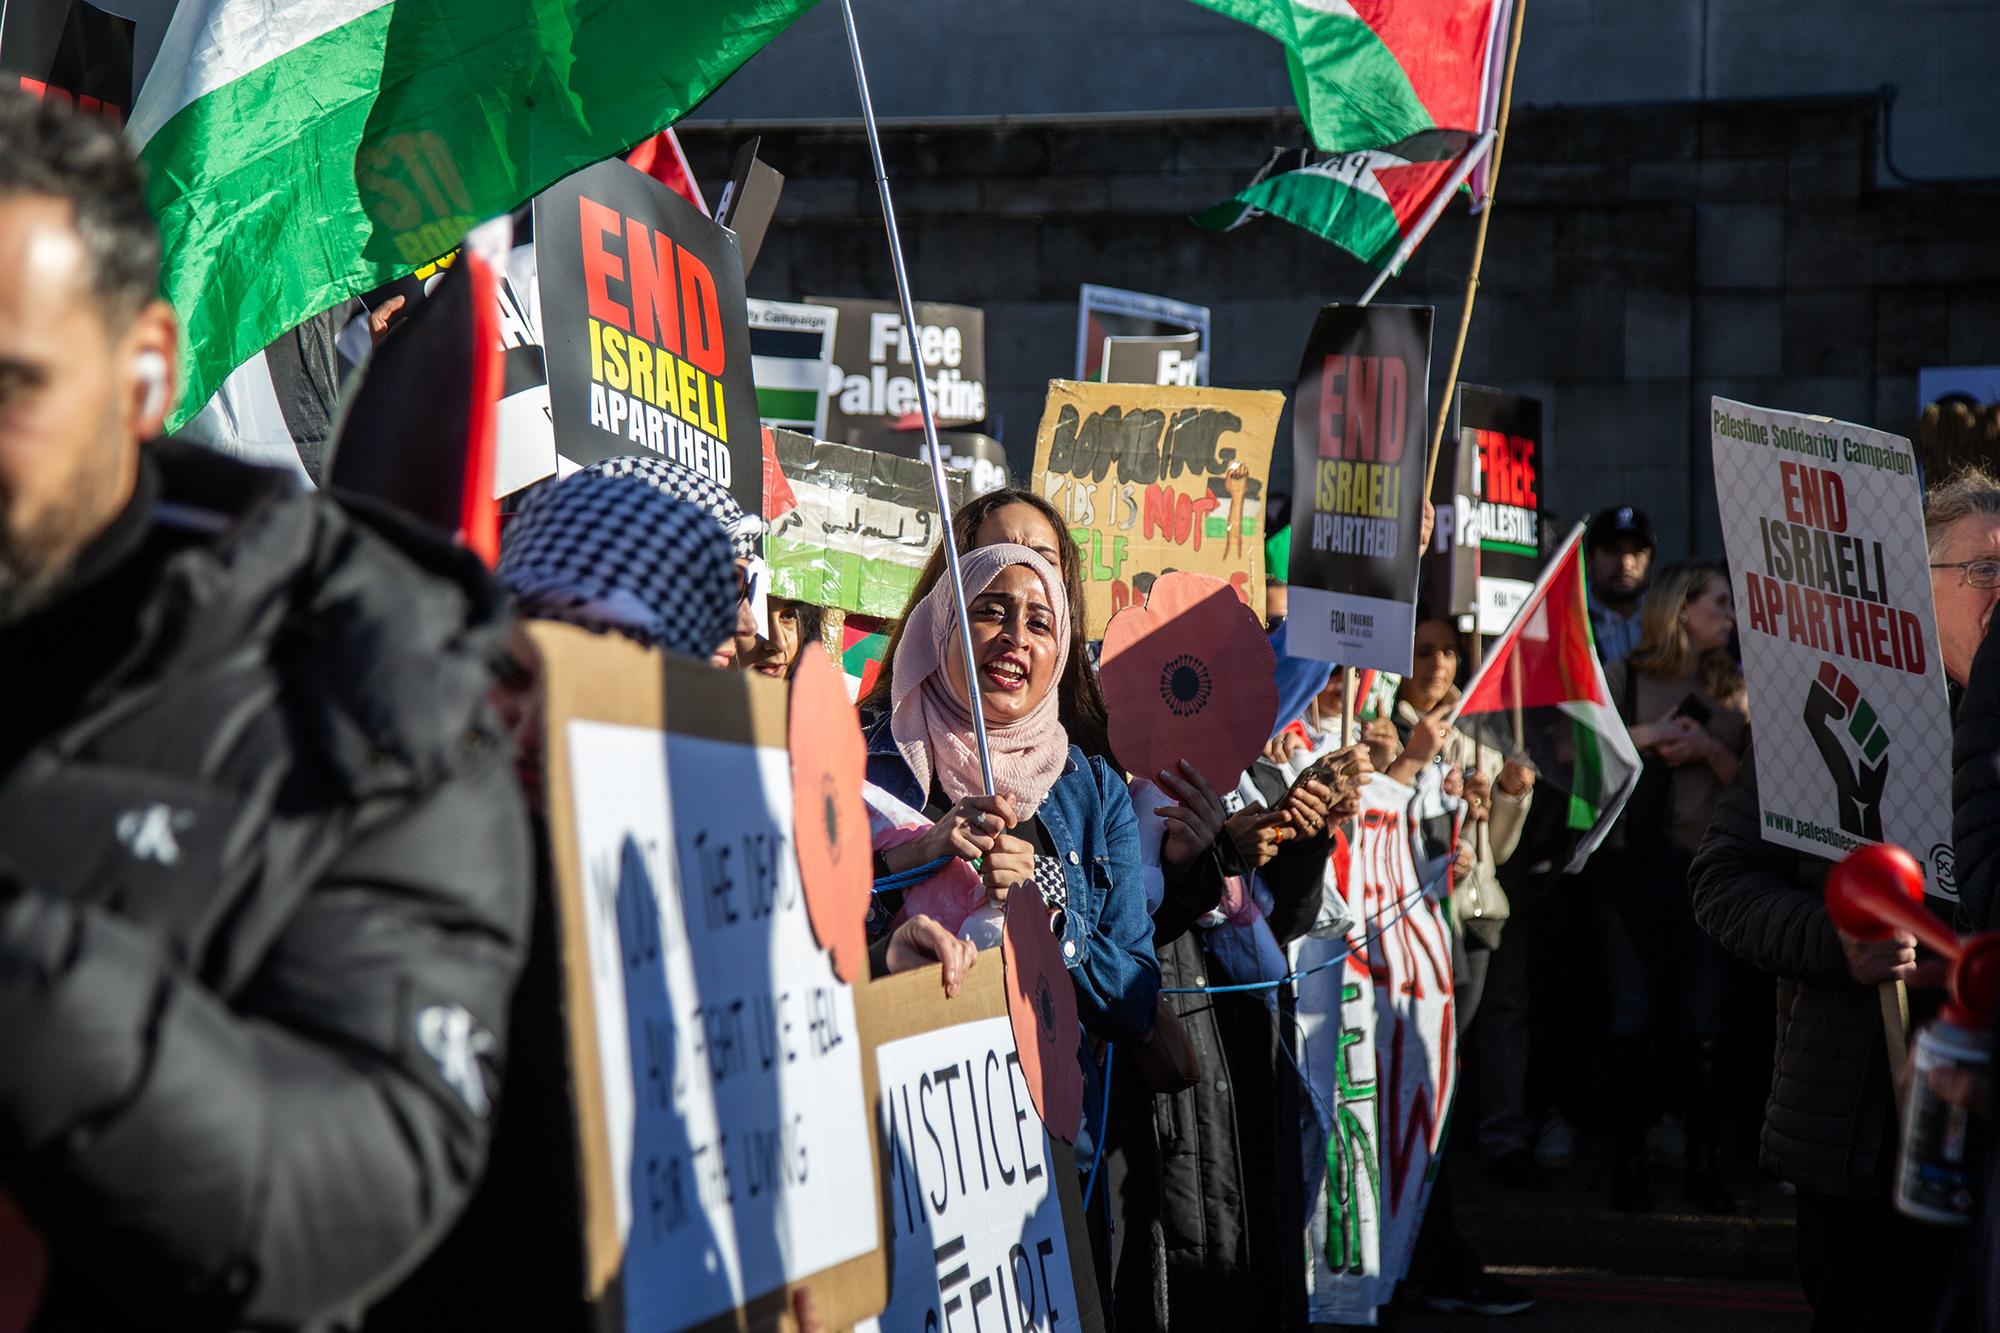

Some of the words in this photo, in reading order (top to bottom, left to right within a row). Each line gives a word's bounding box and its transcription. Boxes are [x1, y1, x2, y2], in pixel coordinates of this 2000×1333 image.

[579, 195, 725, 377] END
[763, 311, 827, 327] Campaign
[588, 317, 728, 443] ISRAELI
[1319, 354, 1408, 463] END
[590, 382, 732, 489] APARTHEID
[1713, 409, 1768, 447] Palestine
[1772, 424, 1838, 463] Solidarity
[1843, 437, 1914, 476] Campaign
[1143, 483, 1212, 552] NOT
[1314, 459, 1400, 520] ISRAELI
[1780, 460, 1848, 533] END
[1068, 527, 1129, 582] ELF
[1312, 512, 1399, 560] APARTHEID
[1480, 502, 1538, 547] ALESTINE
[1759, 516, 1889, 605] ISRAELI
[1331, 610, 1347, 636] FOA
[1746, 571, 1927, 675] APARTHEID
